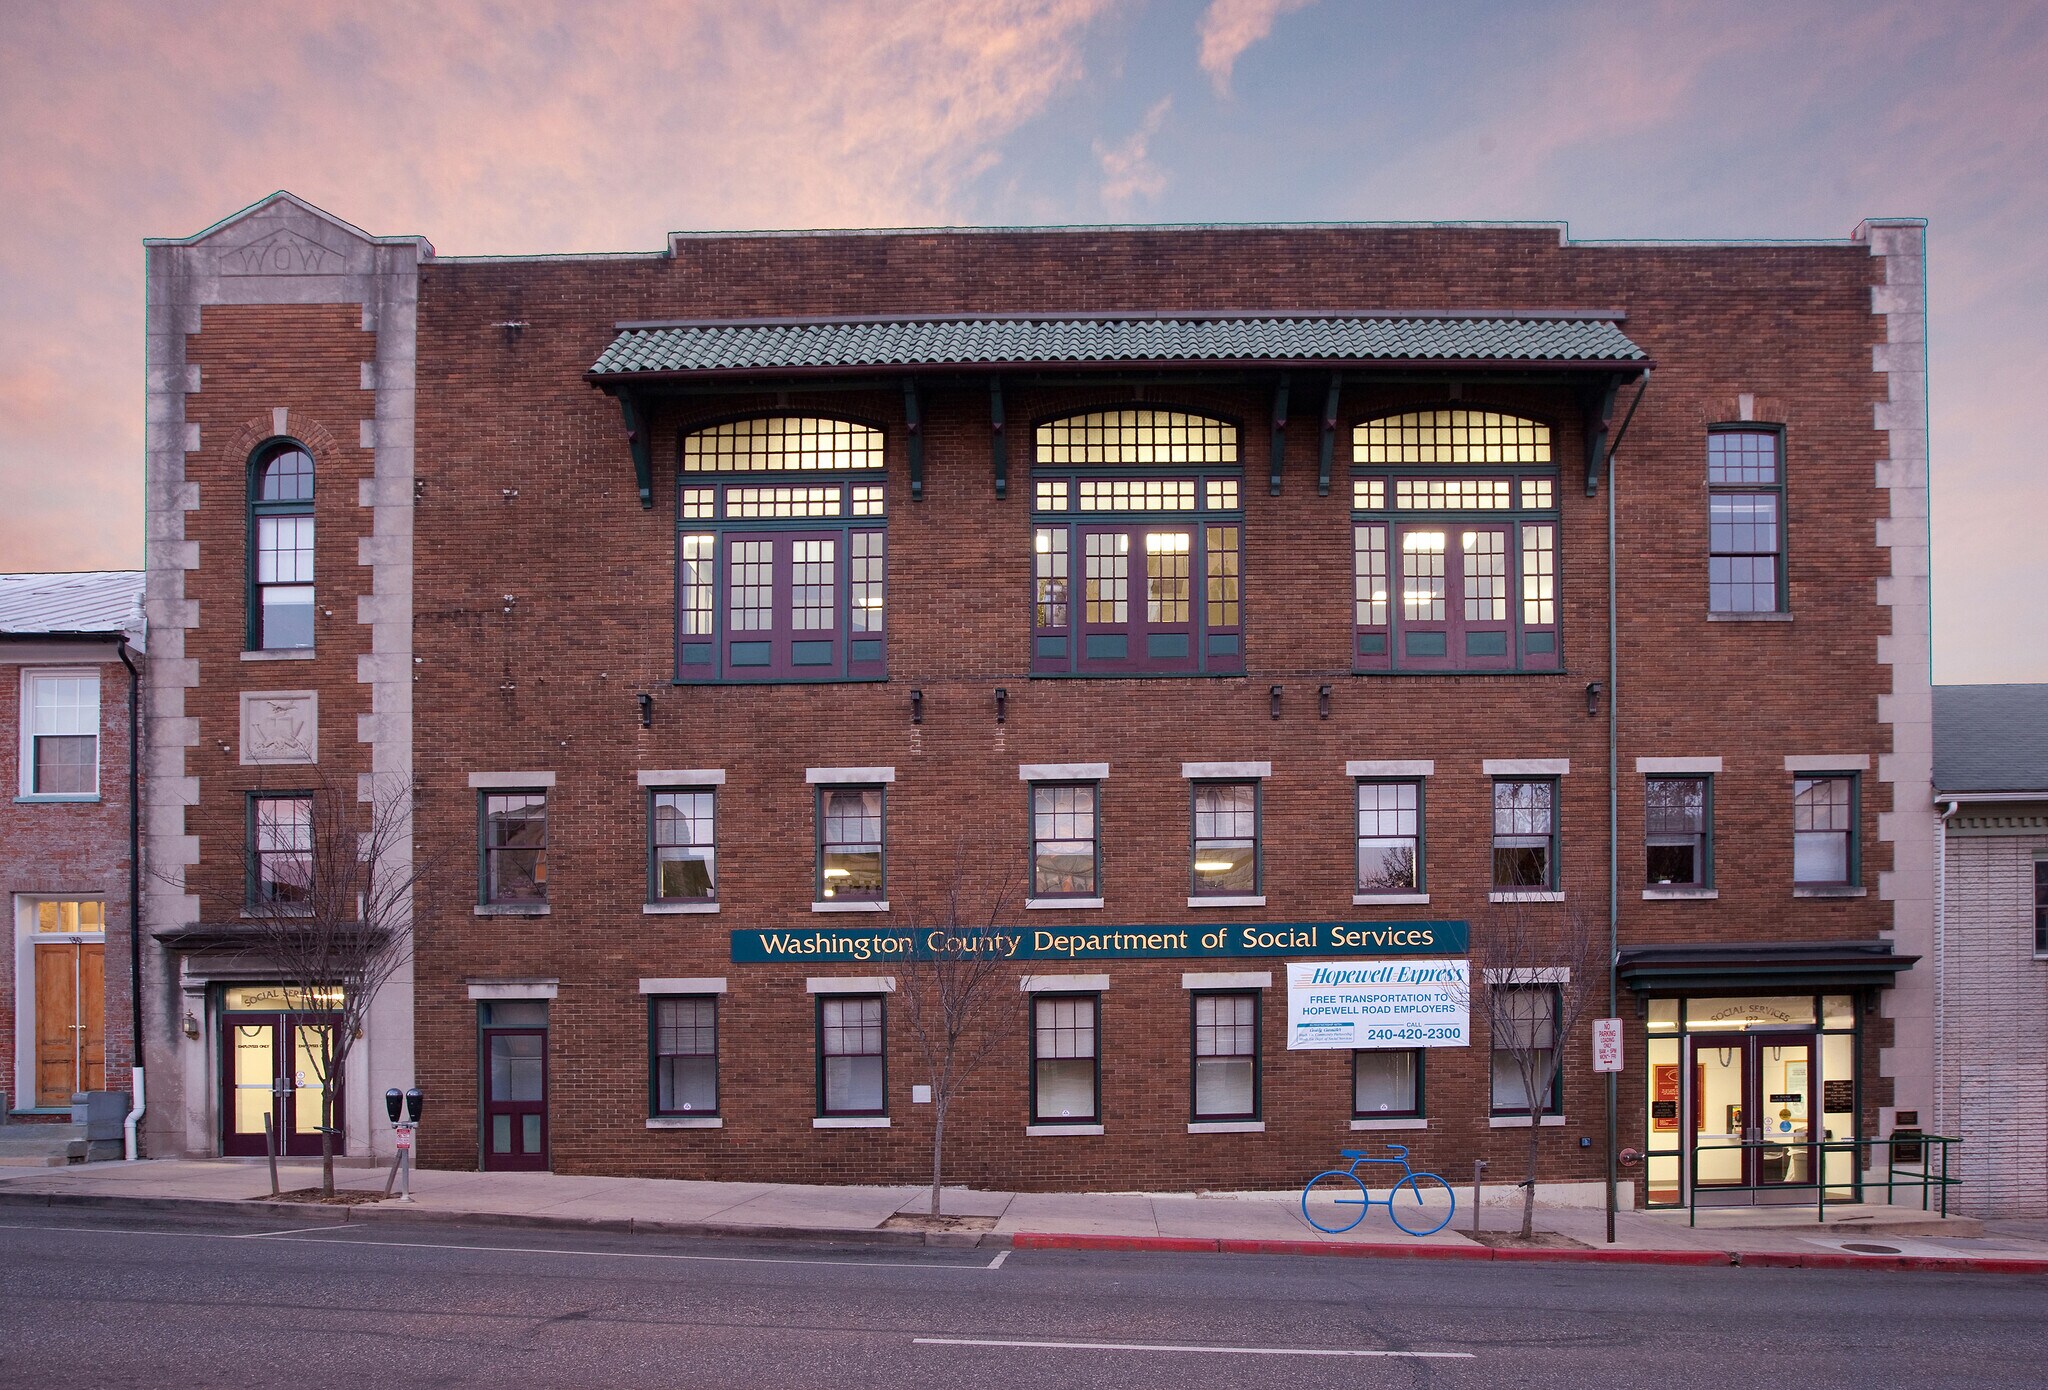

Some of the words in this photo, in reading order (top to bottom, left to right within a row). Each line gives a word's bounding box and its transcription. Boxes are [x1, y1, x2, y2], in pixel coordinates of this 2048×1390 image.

[239, 238, 326, 271] WOW
[759, 932, 913, 960] Washington
[927, 931, 1021, 957] County
[1034, 930, 1188, 957] Department
[1201, 928, 1227, 949] of
[1242, 926, 1317, 948] Social
[1331, 926, 1434, 947] Services
[1311, 966, 1394, 986] Hopewell
[1396, 966, 1465, 985] Express
[244, 989, 280, 1007] SOCIAL
[1310, 995, 1337, 1004] FREE
[1339, 993, 1432, 1003] TRANSPORTATION
[1434, 993, 1449, 1002] TO
[1302, 1006, 1359, 1015] HOPEWELL
[1361, 1005, 1391, 1014] ROAD
[1394, 1004, 1456, 1014] EMPLOYERS
[1710, 1006, 1746, 1021] SOCIAL
[1748, 1004, 1791, 1022] SERVICES
[1367, 1027, 1461, 1040] 240-420-2300
